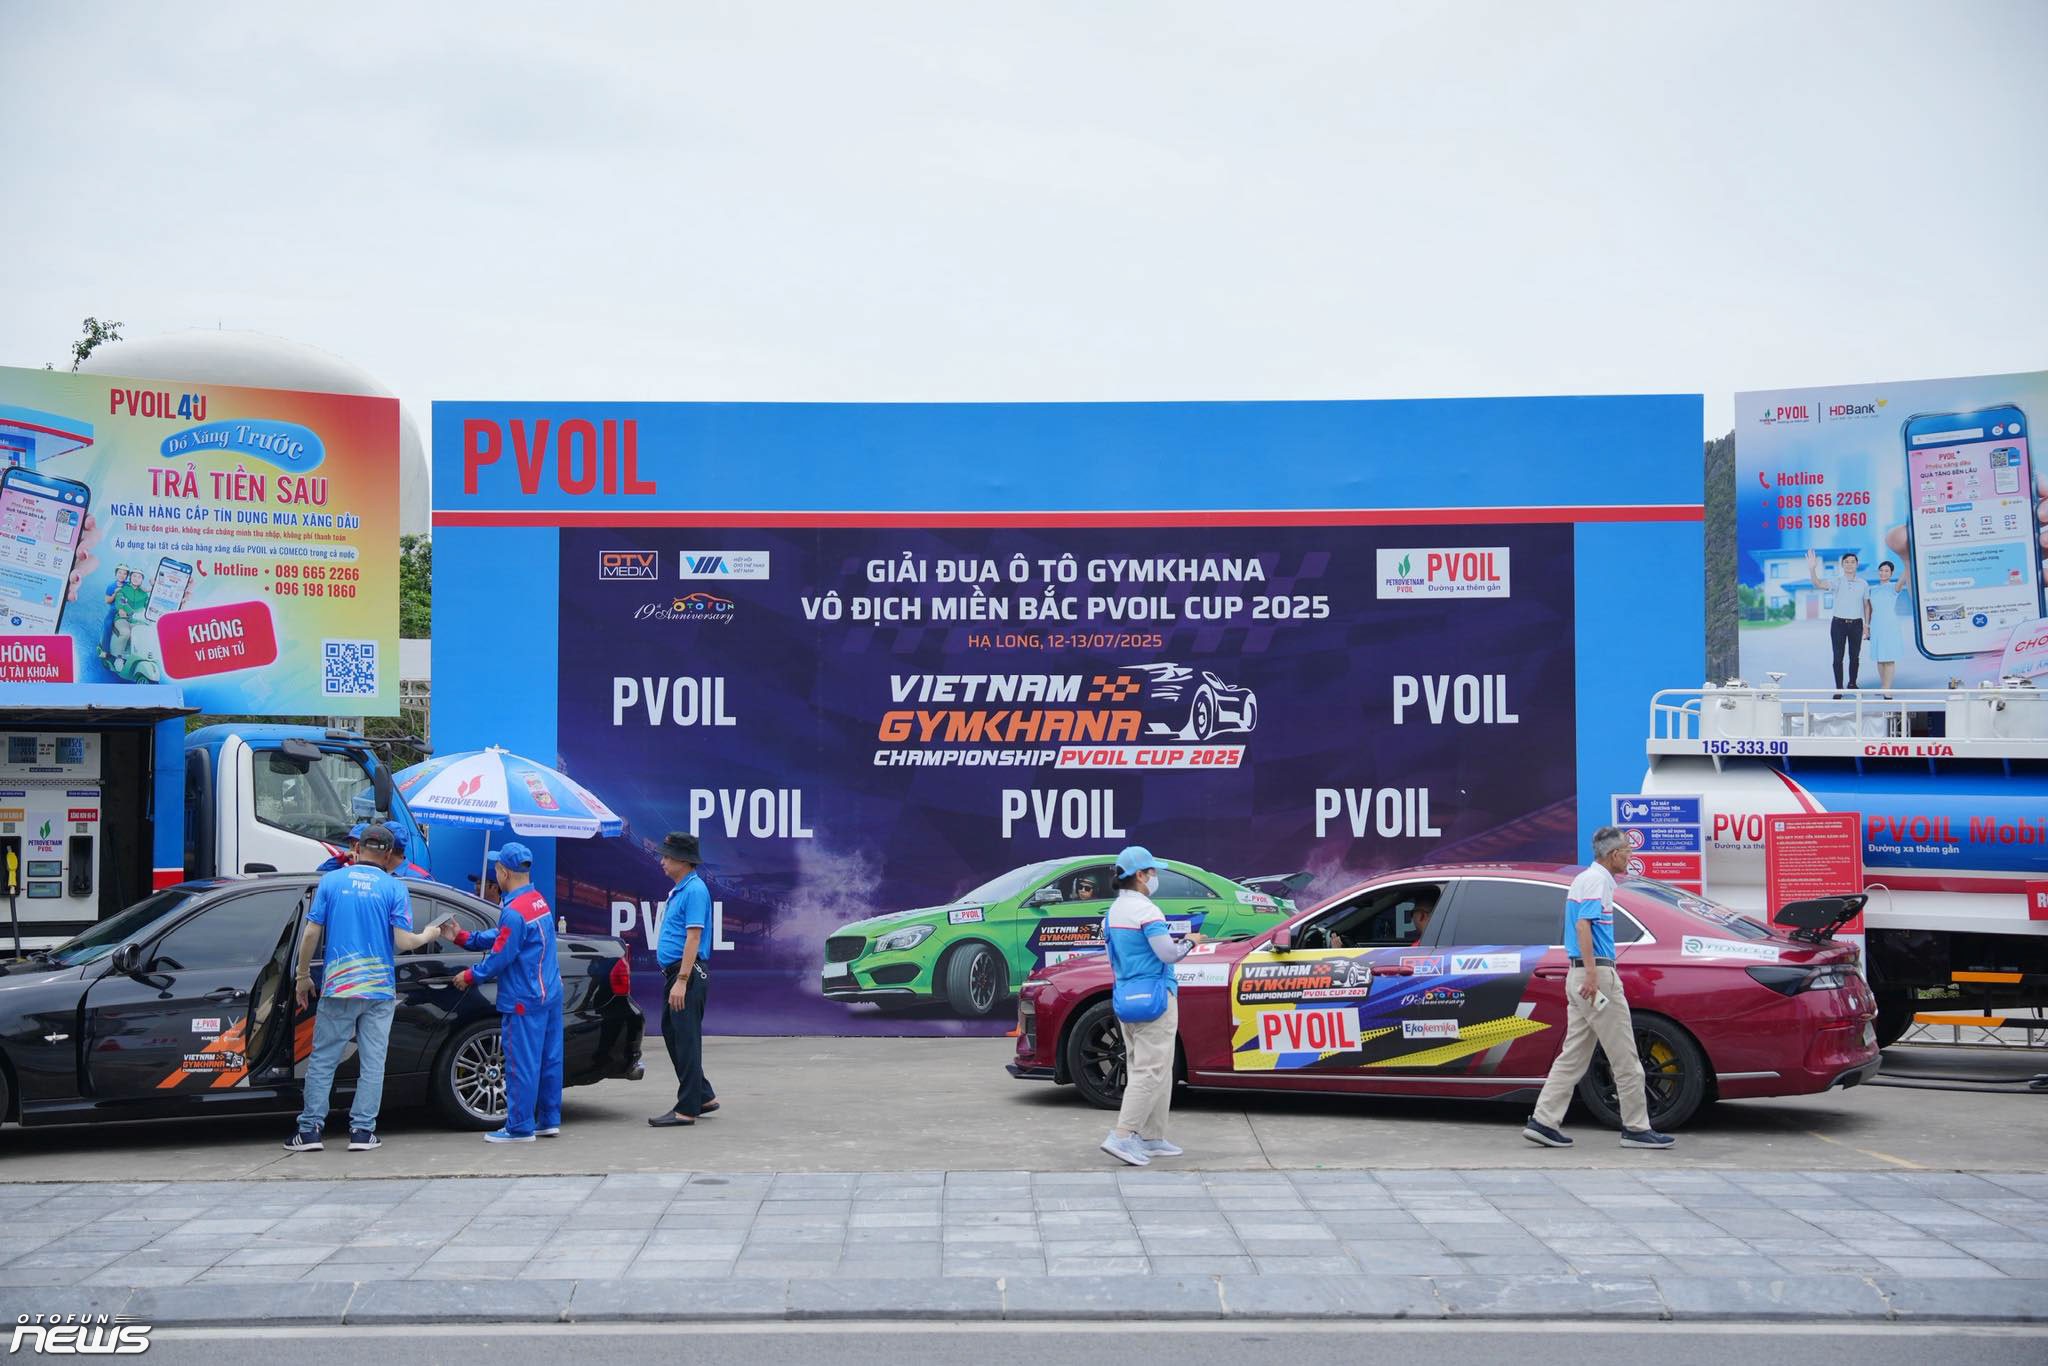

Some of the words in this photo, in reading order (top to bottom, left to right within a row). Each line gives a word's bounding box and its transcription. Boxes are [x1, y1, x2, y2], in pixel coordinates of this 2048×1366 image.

[1777, 405, 1809, 420] PVOIL
[1829, 403, 1876, 416] HDBank
[236, 424, 304, 460] Trước
[463, 418, 657, 496] PVOIL
[148, 462, 199, 498] TRẢ
[210, 464, 266, 503] TIỀN
[276, 475, 329, 506] SAU
[1777, 472, 1824, 486] Hotline
[1777, 495, 1802, 509] 089
[1807, 493, 1832, 508] 665
[1836, 491, 1871, 506] 2266
[111, 502, 143, 517] NGÂN
[149, 504, 180, 519] HÀNG
[186, 505, 209, 520] CẤP
[214, 508, 232, 522] TÍN
[237, 510, 268, 526] DỤNG
[273, 512, 298, 525] MUA
[336, 511, 359, 529] DẦU
[1777, 515, 1803, 530] 096
[1808, 514, 1830, 529] 198
[1835, 512, 1867, 527] 1860
[195, 544, 213, 553] hàng
[247, 545, 267, 555] PVOIL
[279, 546, 308, 557] COMECO
[310, 549, 327, 559] trong
[603, 553, 654, 567] OTV
[866, 551, 926, 583] GIẢI
[935, 559, 1001, 583] ĐUA
[1009, 552, 1029, 583] Ô
[1038, 552, 1078, 583] TÔ
[1087, 558, 1266, 583] GYMKHANA
[1427, 552, 1501, 582] PVOIL
[213, 562, 259, 577] Hotline
[275, 565, 299, 579] 089
[302, 566, 326, 580] 665
[329, 566, 359, 581] 2266
[603, 566, 655, 578] MEDIA
[275, 582, 299, 595] 096
[302, 583, 324, 597] 198
[328, 584, 356, 598] 1860
[1386, 578, 1425, 586] PETROVIETNAM
[1396, 585, 1413, 593] PVOIL
[1428, 584, 1455, 593] Đường
[1466, 583, 1486, 591] thêm
[1487, 582, 1501, 592] gần
[673, 601, 735, 612] OTOFUN
[800, 589, 842, 620] VÔ
[850, 596, 921, 627] ĐỊCH
[931, 584, 1009, 620] MIỀN
[1018, 584, 1078, 620] BẮC
[1087, 596, 1176, 620] PVOIL
[1184, 596, 1244, 620] CUP
[1252, 595, 1331, 620] 2025
[655, 607, 735, 624] Anniversary
[188, 618, 244, 644] KHÔNG
[968, 634, 992, 650] HẠ
[996, 634, 1045, 650] LONG,
[1047, 634, 1163, 649] 12-13/07/2025
[195, 647, 206, 662] VÍ
[207, 645, 230, 661] ĐIỆN
[231, 641, 245, 656] TỬ
[9, 663, 26, 677] TÀI
[27, 663, 59, 677] KHOẢN
[889, 674, 1083, 702] VIETNAM
[613, 676, 737, 726] PVOIL
[1393, 674, 1519, 725] PVOIL
[877, 709, 1143, 742] GYMKHANA
[1702, 740, 1789, 755] 15C-333.90
[1864, 742, 1909, 756] CẤM
[1916, 742, 1954, 756] LỬA
[873, 748, 1057, 767] CHAMPIONSHIP
[1060, 749, 1128, 766] PVOIL
[1135, 749, 1184, 765] CUP
[1191, 749, 1242, 765] 2025
[428, 794, 498, 809] PETROVIETNAM
[690, 788, 812, 839] PVOIL
[1002, 788, 1126, 839] PVOIL
[1315, 787, 1442, 838] PVOIL
[1713, 814, 1763, 841] PVO
[1867, 815, 1960, 843] PVOIL
[1714, 842, 1741, 851] Đường
[1868, 844, 1901, 854] Đường
[1916, 845, 1940, 853] thêm
[1942, 844, 1960, 855] gần
[352, 879, 372, 890] PVOIL
[961, 910, 980, 919] PVOIL
[611, 901, 735, 951] PVL
[1041, 926, 1079, 934] VIETNAM
[1039, 933, 1090, 941] GYMKHANA
[1244, 964, 1312, 979] VIETNAM
[1241, 976, 1332, 992] GYMKHANA
[1240, 991, 1303, 1001] CHAMPIONSHIP
[1303, 989, 1328, 997] PVOIL
[1263, 1011, 1355, 1051] PVOIL
[1405, 1021, 1457, 1037] Ekokemika
[182, 1060, 225, 1068] GYMKHANA
[183, 1053, 216, 1061] VIETNAM
